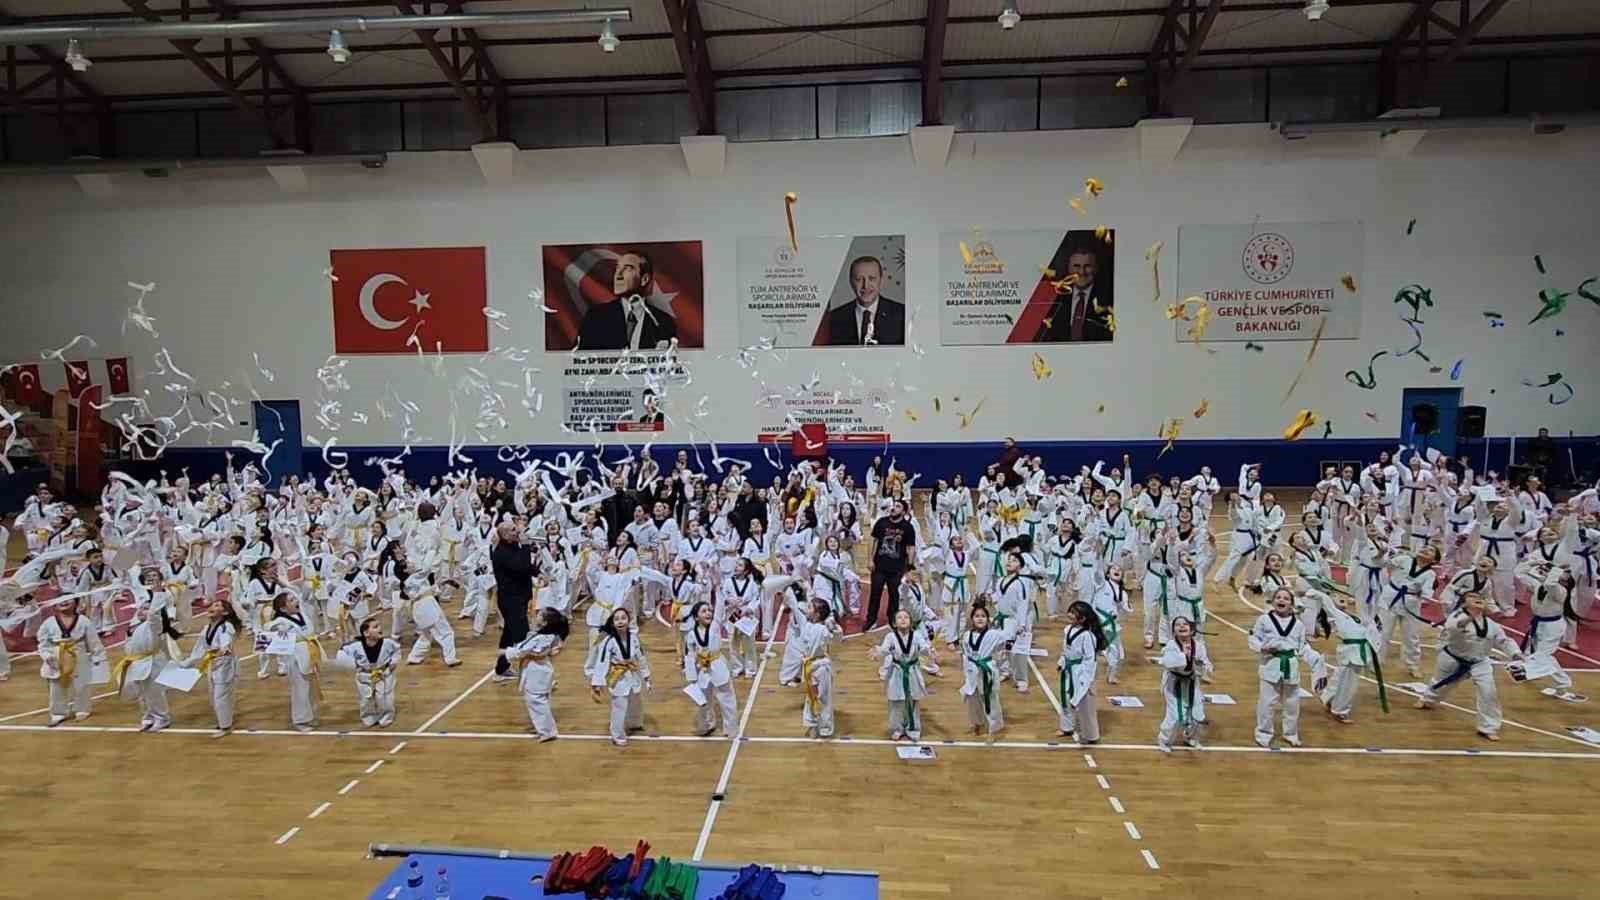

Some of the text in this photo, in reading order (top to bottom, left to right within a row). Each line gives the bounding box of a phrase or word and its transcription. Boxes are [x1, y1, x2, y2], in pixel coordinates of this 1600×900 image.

[1204, 287, 1335, 301] TÜRKİYE CUMHURİYETİ
[1217, 304, 1268, 318] GENÇLİK
[1271, 306, 1285, 315] VE
[1235, 320, 1300, 332] BAKANLIĞI
